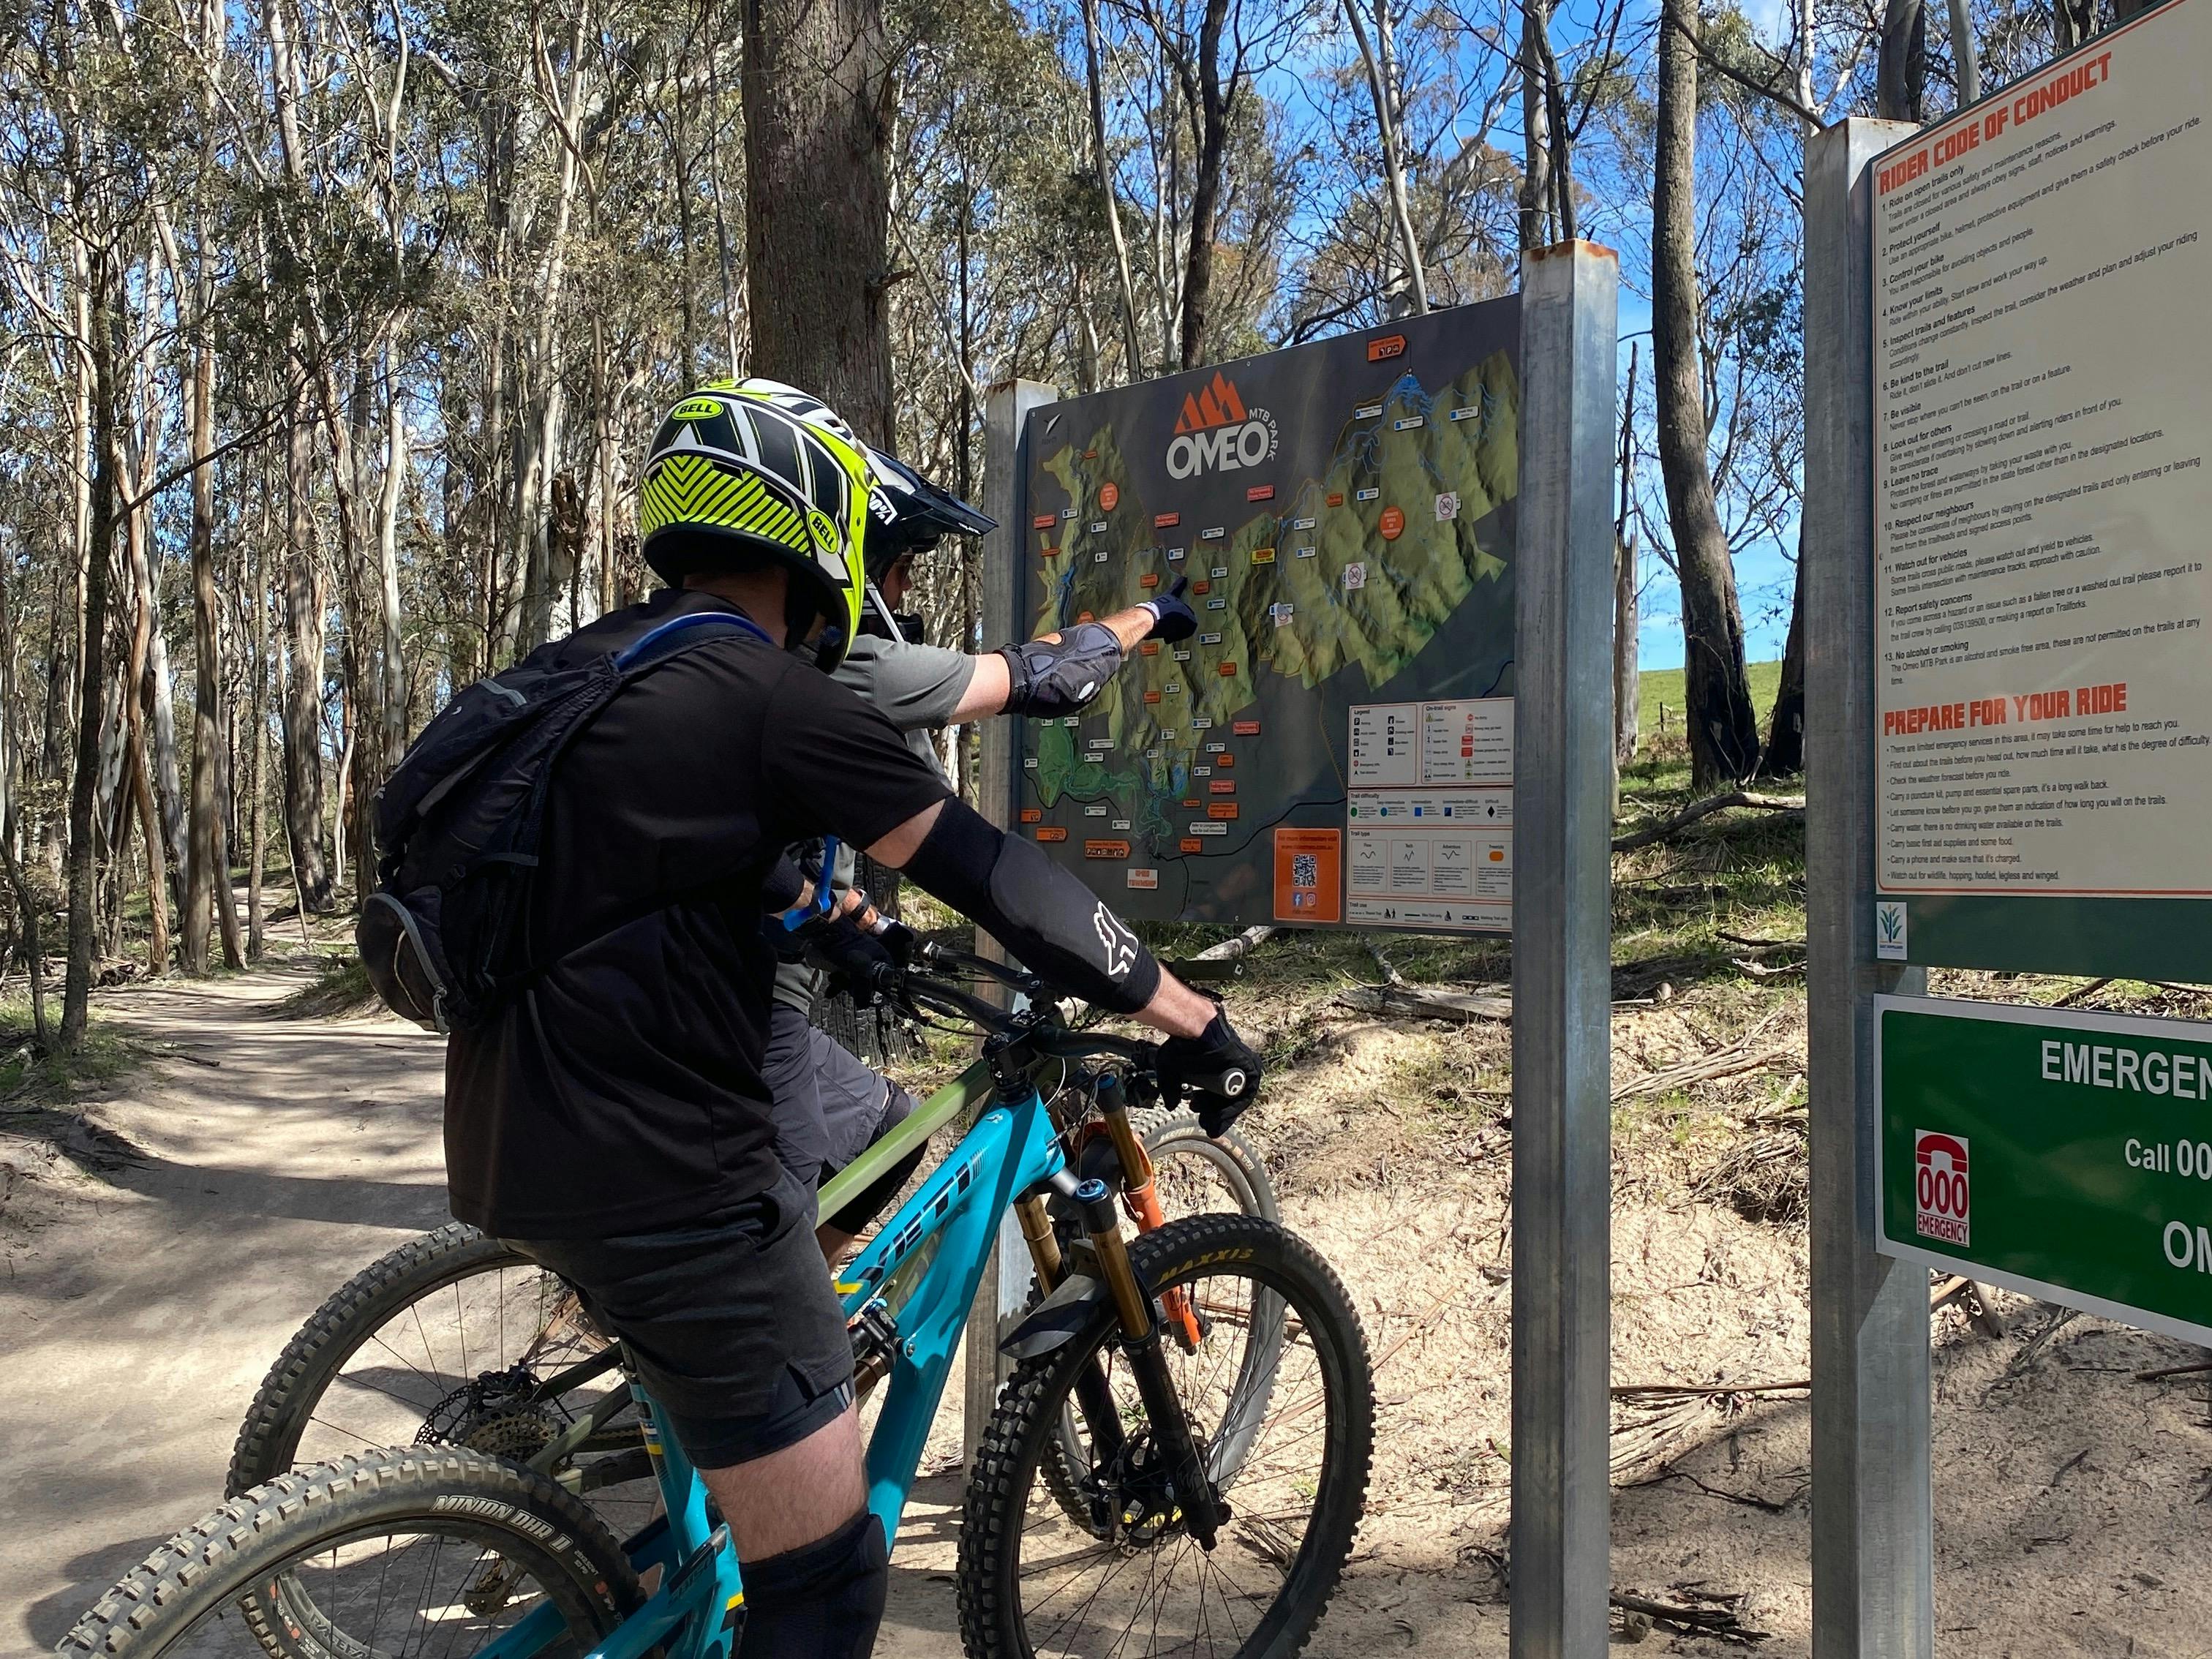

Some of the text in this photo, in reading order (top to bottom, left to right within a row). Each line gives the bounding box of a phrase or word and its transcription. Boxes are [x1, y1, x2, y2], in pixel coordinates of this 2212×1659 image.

[1880, 52, 2111, 195] RIDER CODE OF CONDUCT
[1888, 209, 1903, 221] Trails
[1903, 205, 1913, 214] are
[1913, 194, 1931, 209] closed
[1931, 191, 1940, 200] for
[1941, 181, 1961, 195] various
[1962, 171, 1980, 185] safety
[1981, 163, 1993, 176] and
[1993, 146, 2033, 169] maintenance
[1888, 222, 1904, 234] Never
[1904, 214, 1919, 227] enter
[1924, 201, 1943, 217] closed
[1944, 196, 1957, 208] area
[1957, 188, 1969, 201] and
[1970, 180, 1990, 195] always
[1991, 173, 2006, 184] obey
[2044, 143, 2068, 159] notices
[2069, 134, 2083, 147] and
[1889, 195, 1903, 208] Ride
[1904, 191, 1913, 200] on
[1914, 182, 1930, 196] open
[1931, 173, 1948, 187] trails
[1949, 165, 1964, 178] only
[1889, 235, 1912, 253] Protect
[1913, 222, 1940, 244] yourself
[1888, 287, 1899, 296] You
[1899, 282, 1909, 291] are
[1909, 268, 1941, 286] responsible
[1941, 263, 1949, 272] for
[1950, 253, 1975, 269] avoiding
[1976, 243, 1997, 257] objects
[1998, 236, 2011, 249] and
[1889, 266, 1913, 283] Control
[1914, 260, 1929, 275] your
[1930, 254, 1944, 266] bike
[1889, 301, 1908, 315] Know
[1908, 294, 1924, 309] your
[1925, 287, 1943, 300] limits
[1889, 329, 1914, 345] Inspect
[1914, 323, 1931, 335] trails
[1932, 315, 1946, 328] and
[1946, 306, 1975, 322] features
[1889, 378, 1899, 388] Be
[1900, 372, 1914, 384] kind
[1914, 370, 1922, 379] to
[1922, 366, 1934, 376] the
[1935, 358, 1949, 372] trail
[677, 402, 715, 415] BELL
[1890, 410, 1899, 419] Be
[1900, 402, 1921, 415] visible
[1249, 407, 1279, 462] MTB PARK
[1890, 438, 1906, 450] Look
[1907, 433, 1918, 445] out
[1919, 431, 1929, 440] for
[1930, 424, 1952, 437] others
[1166, 421, 1269, 480] OMEO
[1890, 475, 1910, 486] Leave
[1911, 472, 1919, 481] no
[1920, 467, 1938, 478] trace
[1895, 514, 1922, 527] Respect
[1922, 512, 1934, 522] our
[1935, 502, 1974, 517] neighbours
[810, 514, 835, 550] BELL
[1895, 560, 1915, 571] Watch
[1916, 556, 1927, 567] out
[1927, 554, 1938, 564] for
[1939, 549, 1967, 561] vehicles
[1895, 603, 1917, 615] Report
[1918, 599, 1938, 610] safety
[1940, 593, 1972, 606] concerns
[1895, 650, 1905, 660] No
[1906, 646, 1930, 658] alcohol
[1930, 646, 1938, 654] or
[1940, 641, 1968, 652] smoking
[1884, 682, 2126, 735] PREPARE FOR YOUR RIDE
[1889, 854, 1906, 865] Carry
[1911, 855, 1928, 865] phone
[1929, 854, 1941, 863] and
[1941, 854, 1957, 863] make
[1957, 855, 1971, 863] sure
[1972, 854, 1984, 863] that
[1985, 854, 1994, 862] it's
[1129, 879, 1156, 887] TOWNSHIP
[2125, 1138, 2170, 1173] Call
[1918, 1166, 1968, 1219] 000
[1918, 1214, 1968, 1243] EMERGENCY
[1153, 1248, 1254, 1287] MAXXIS
[429, 1495, 515, 1521] MINION
[508, 1509, 555, 1540] DHR
